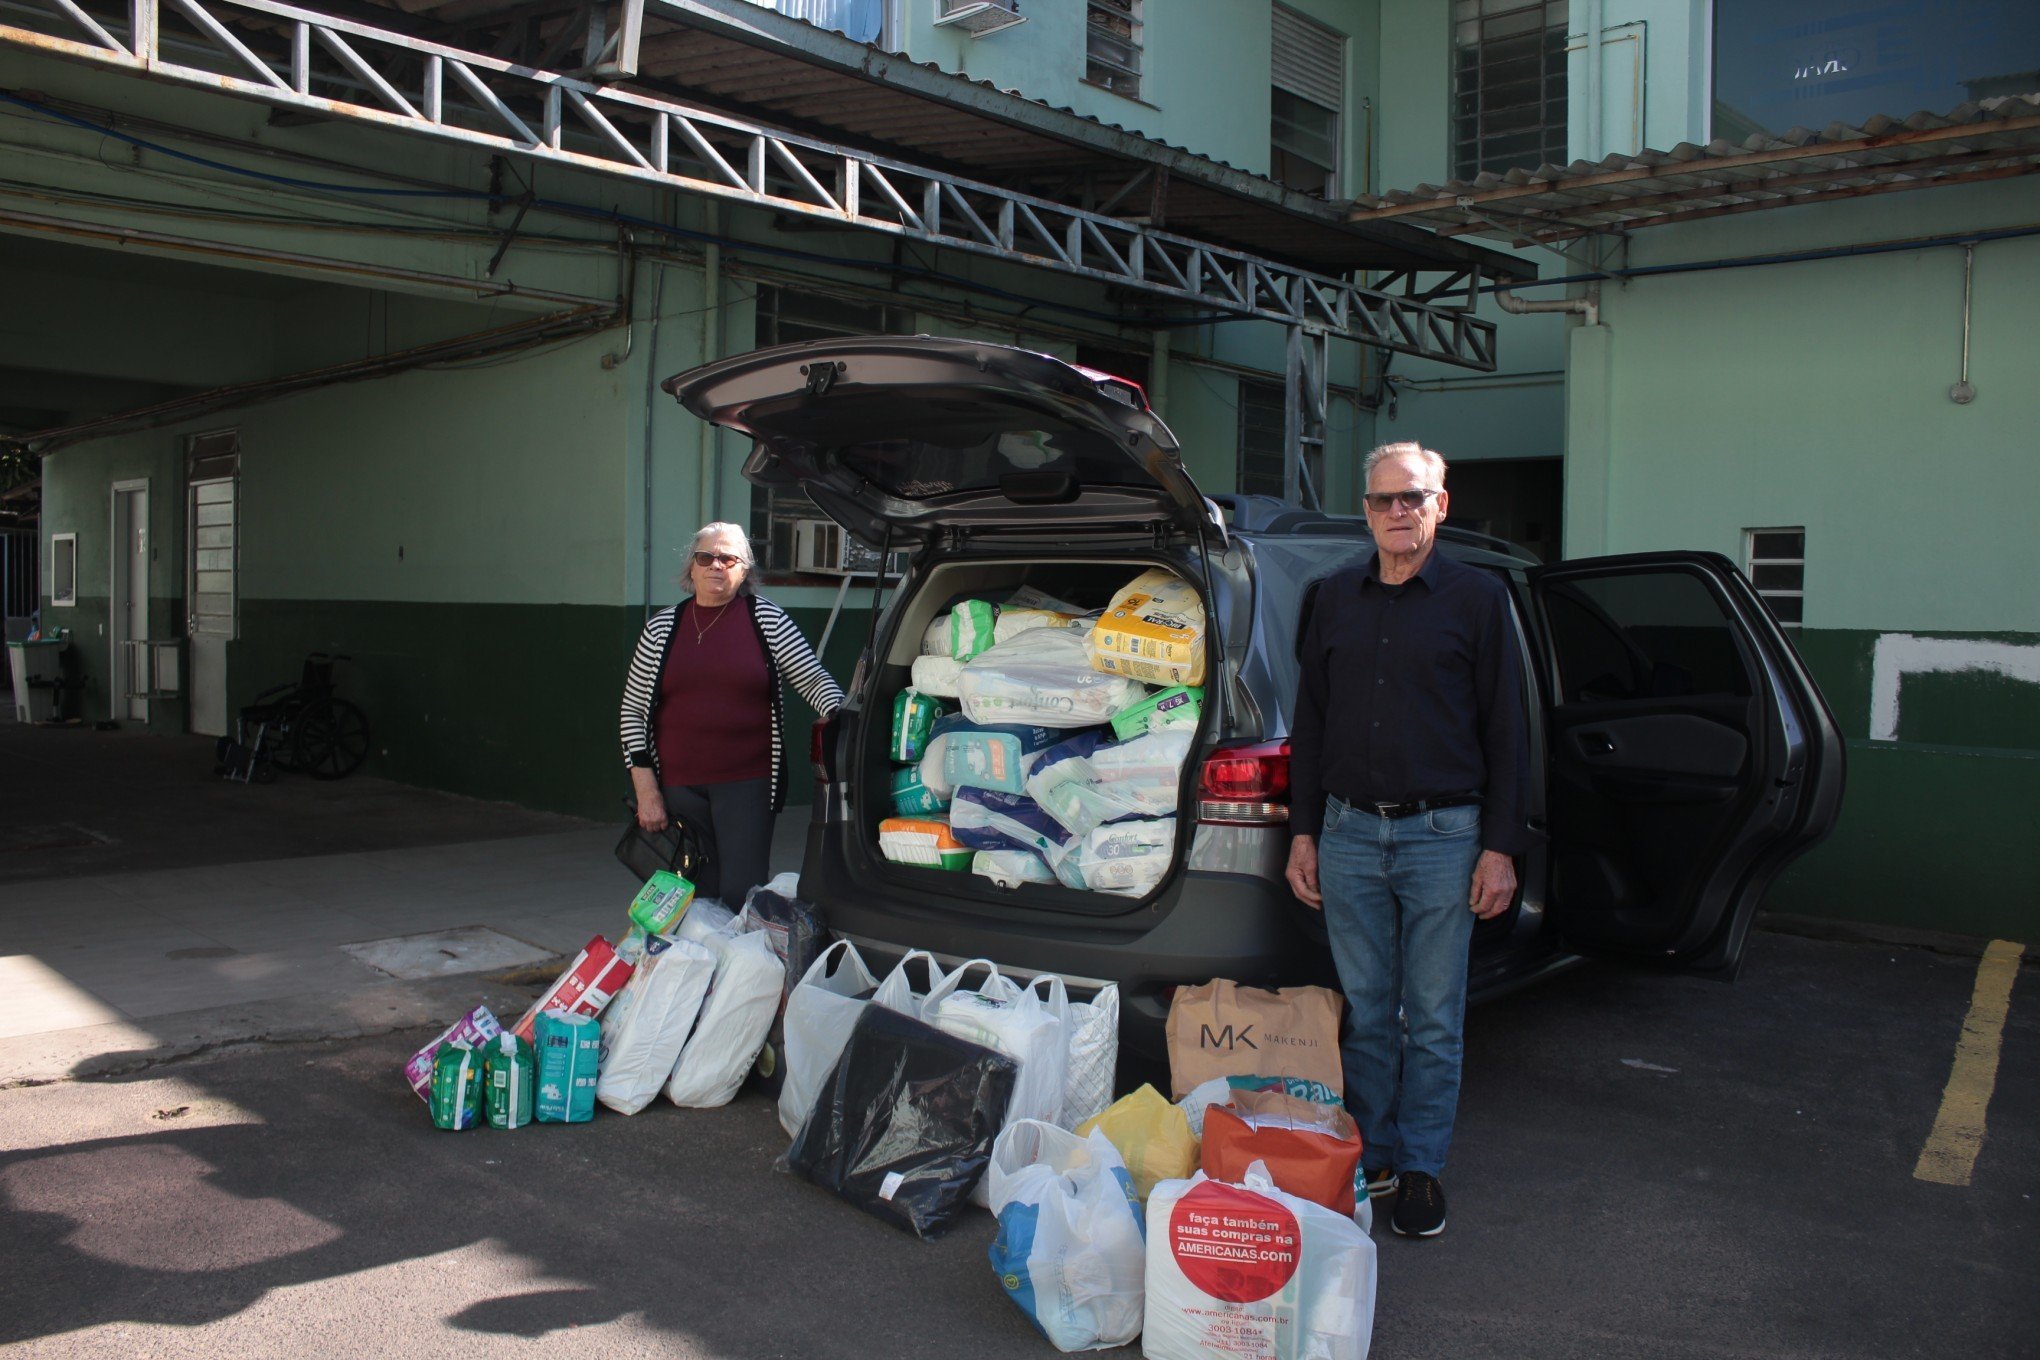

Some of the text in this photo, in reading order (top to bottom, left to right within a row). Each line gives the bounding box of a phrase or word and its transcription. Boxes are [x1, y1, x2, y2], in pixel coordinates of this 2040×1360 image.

[1200, 1023, 1259, 1051] MK
[1264, 1033, 1319, 1048] MAKENJI
[1188, 1212, 1280, 1231] faça também
[1177, 1225, 1293, 1245] suas compras na
[1177, 1241, 1293, 1263] AMERICANAS.com
